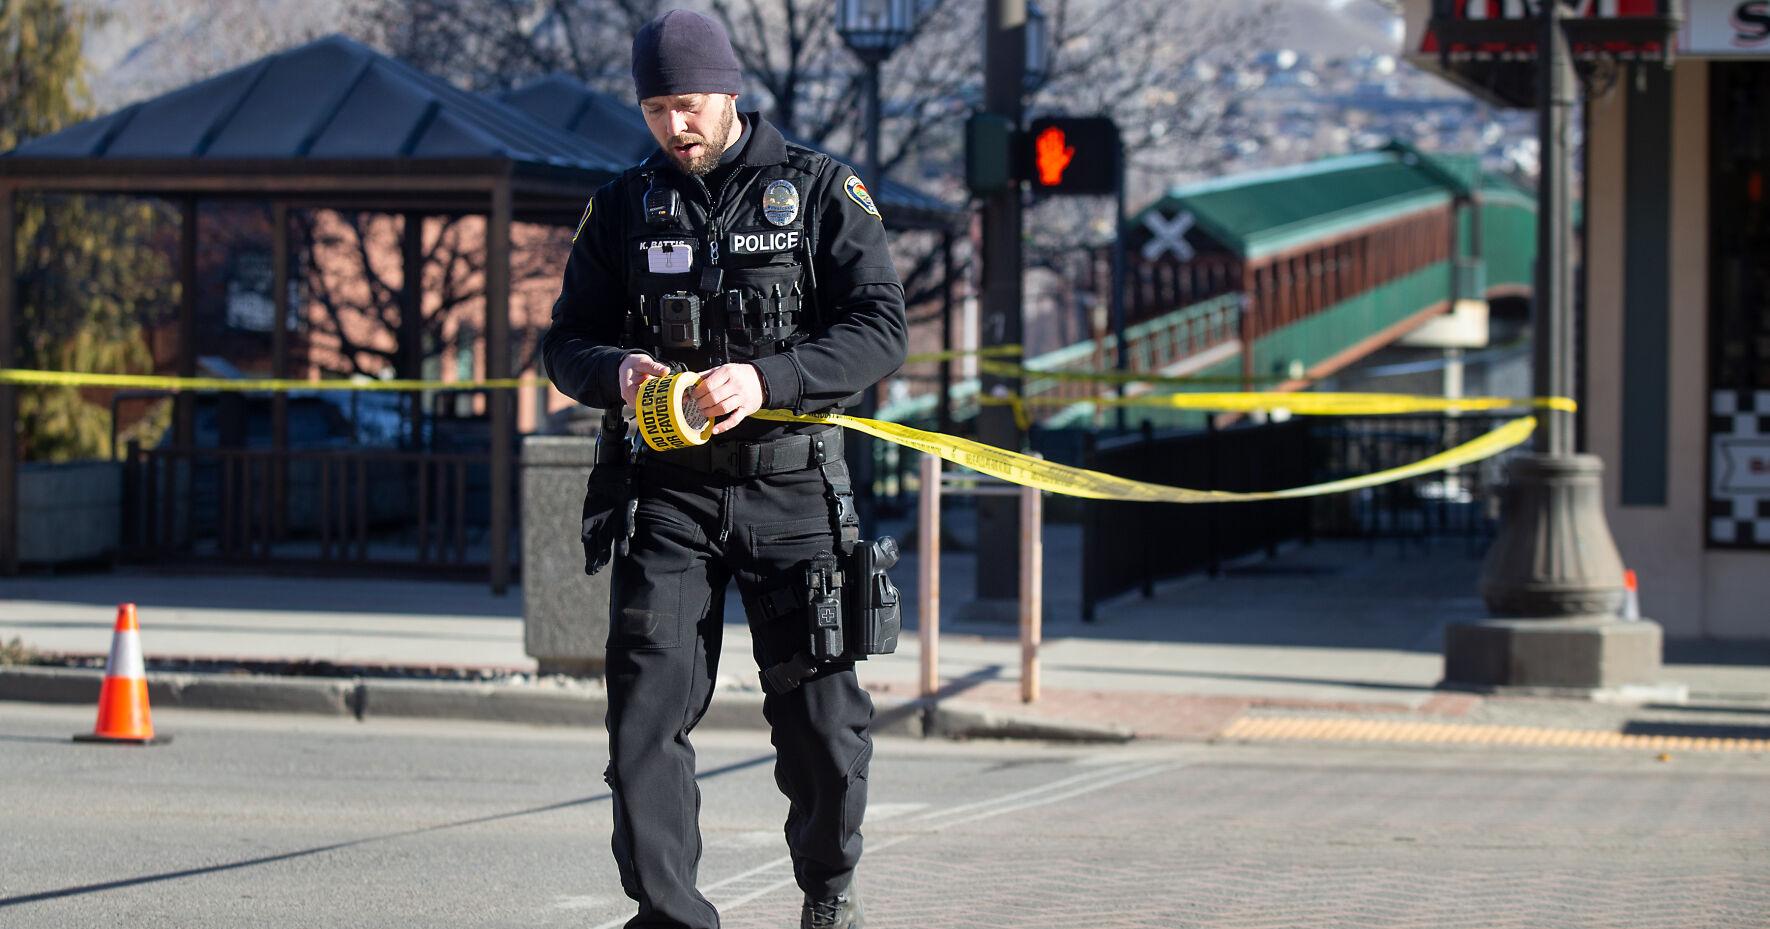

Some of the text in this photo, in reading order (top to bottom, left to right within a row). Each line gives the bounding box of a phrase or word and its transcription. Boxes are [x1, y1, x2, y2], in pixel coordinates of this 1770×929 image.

[639, 241, 649, 251] K.
[734, 231, 799, 253] POLICE
[643, 411, 659, 434] NOT
[656, 379, 684, 449] OR FAVOR NO
[653, 436, 668, 447] DO
